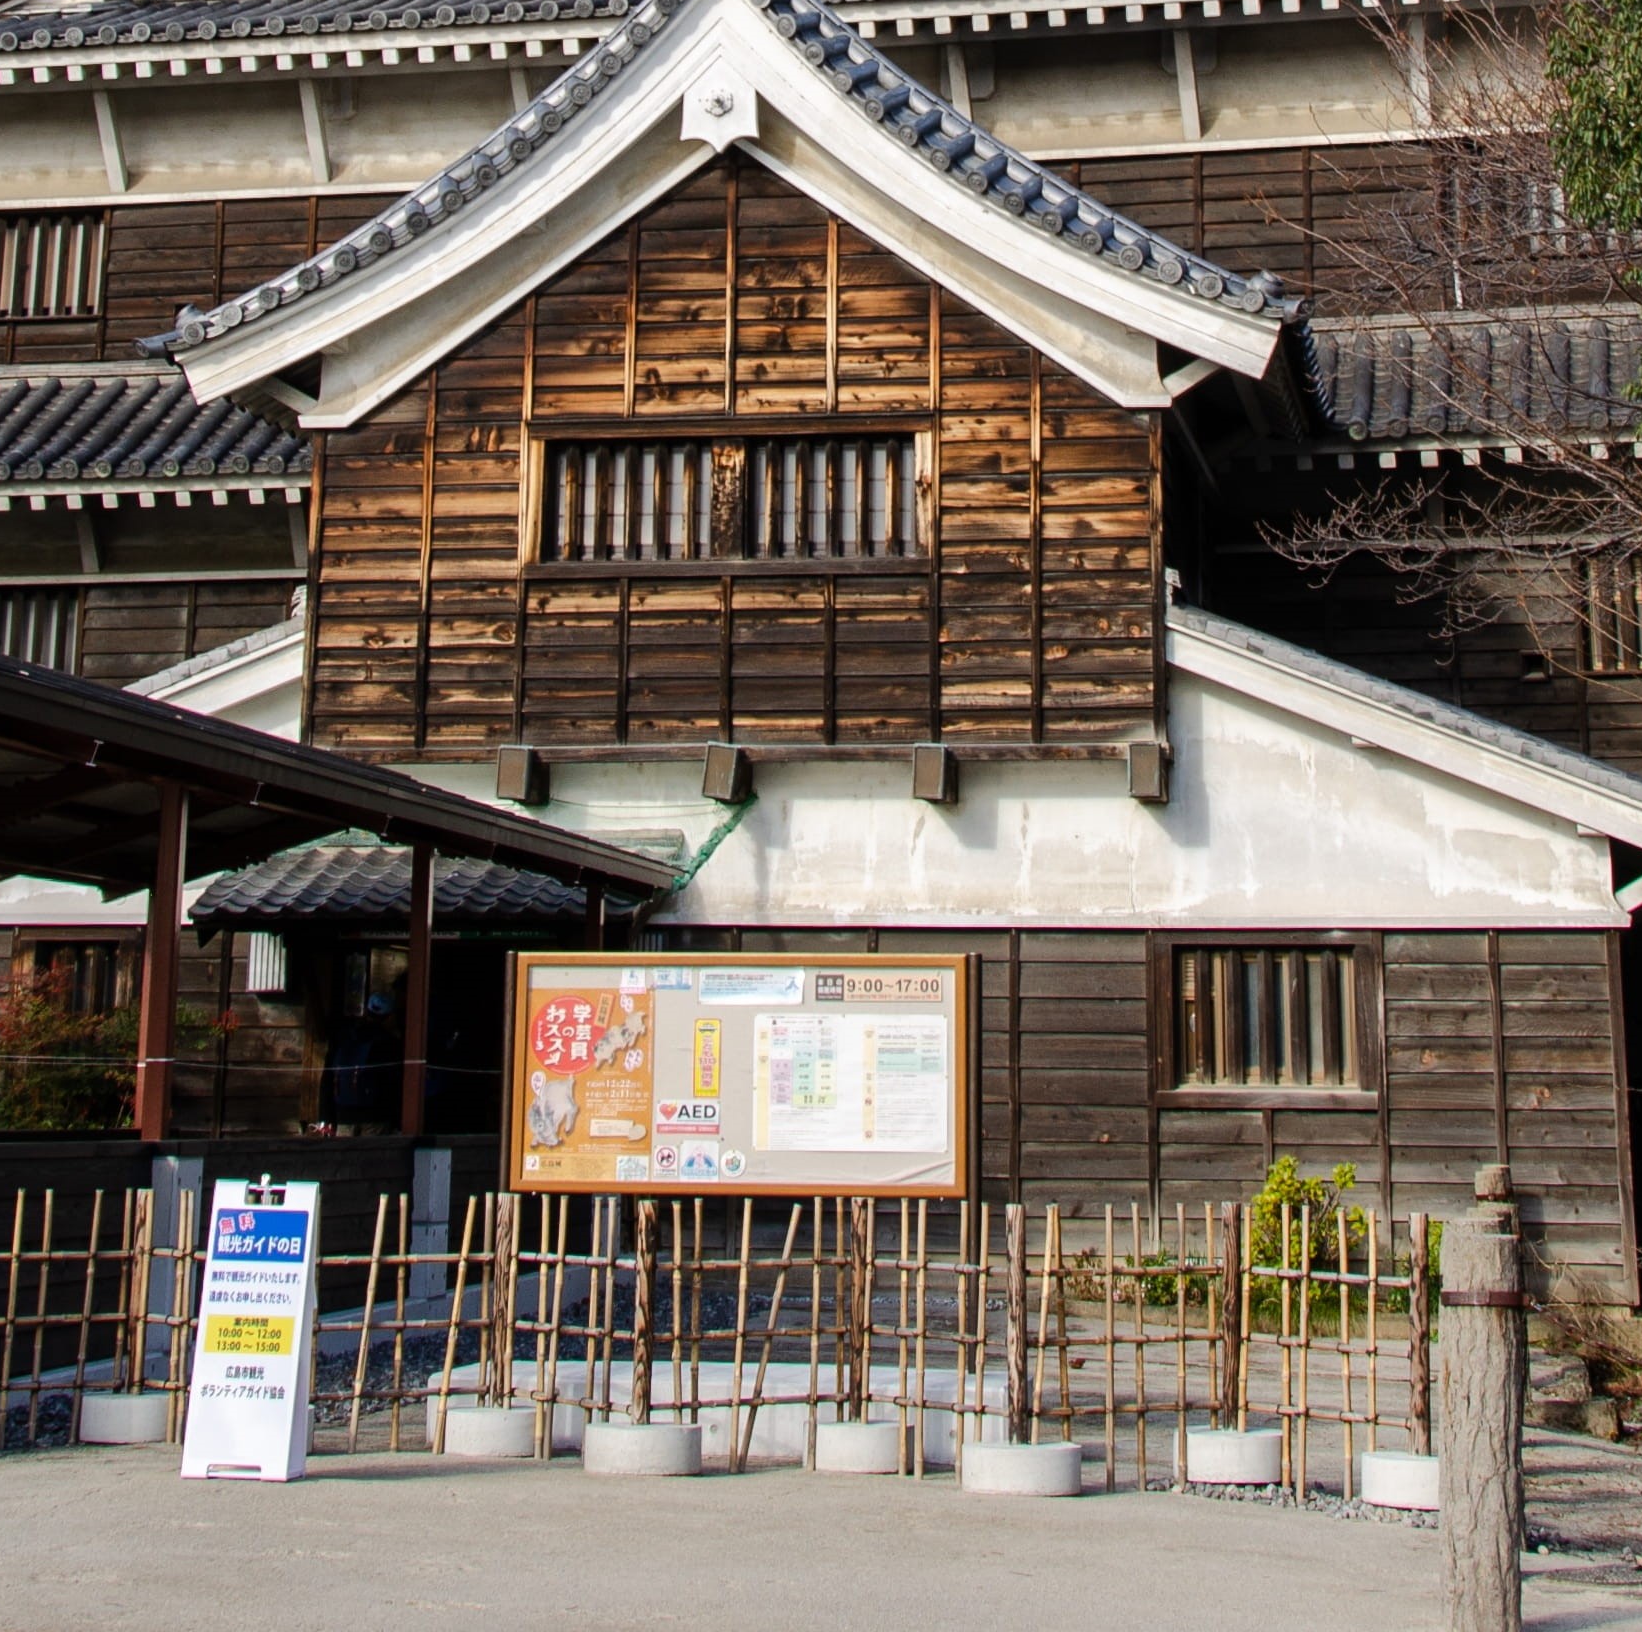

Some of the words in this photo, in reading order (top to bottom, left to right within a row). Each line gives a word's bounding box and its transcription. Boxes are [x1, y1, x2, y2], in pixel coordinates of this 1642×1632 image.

[571, 1004, 593, 1061] 学芸員
[678, 1105, 717, 1119] AED
[219, 1211, 256, 1234] 無料
[218, 1235, 302, 1255] 観光ガイドの日
[234, 1317, 269, 1327] 案内時間
[218, 1328, 243, 1338] 10:00
[258, 1329, 282, 1339] 12:00
[216, 1340, 241, 1351] 13:00
[256, 1342, 280, 1352] 15:00
[225, 1366, 265, 1380] 広島市観光
[201, 1383, 286, 1400] ボランティアガイド協会
